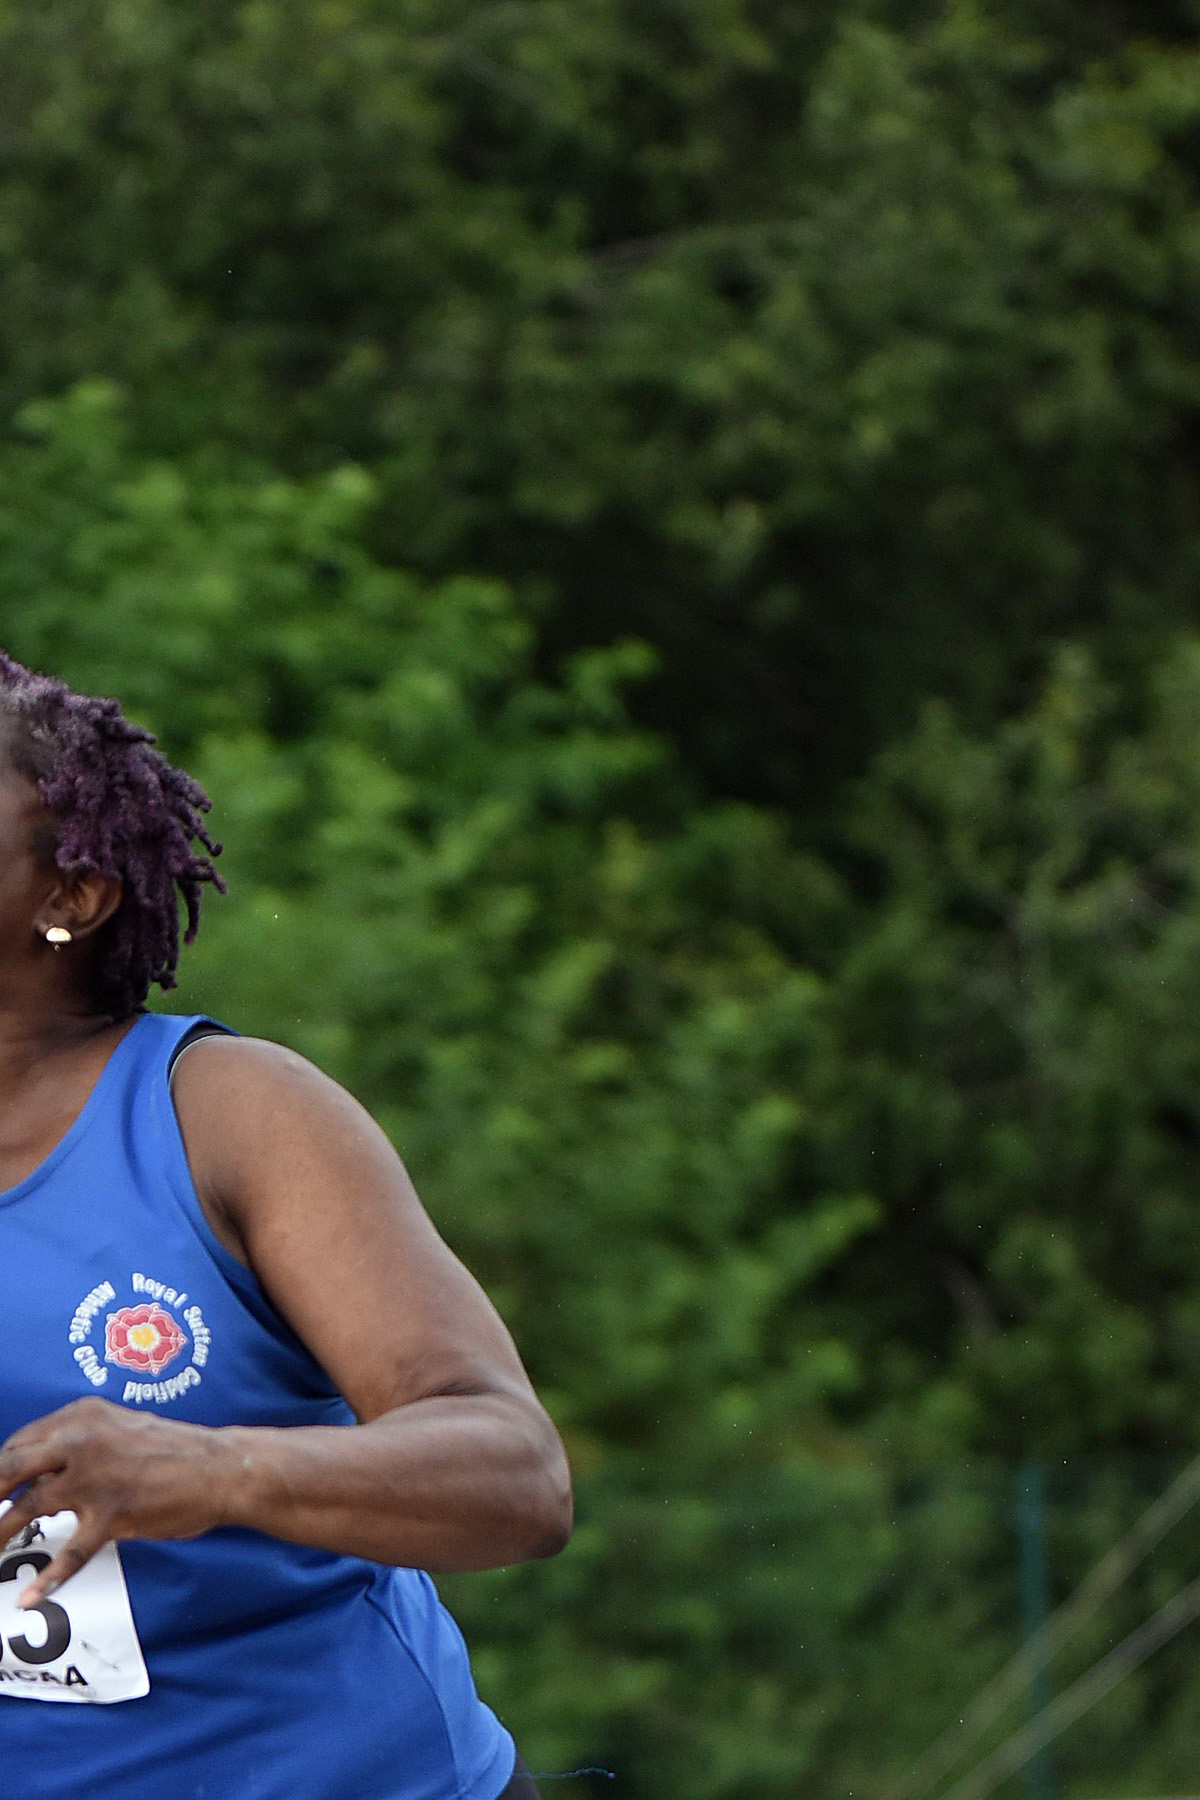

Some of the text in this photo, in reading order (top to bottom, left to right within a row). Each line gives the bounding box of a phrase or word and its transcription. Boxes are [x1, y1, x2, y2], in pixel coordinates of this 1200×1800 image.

[73, 1346, 108, 1387] Club
[122, 1272, 212, 1404] Royal Sutton Coldfield
